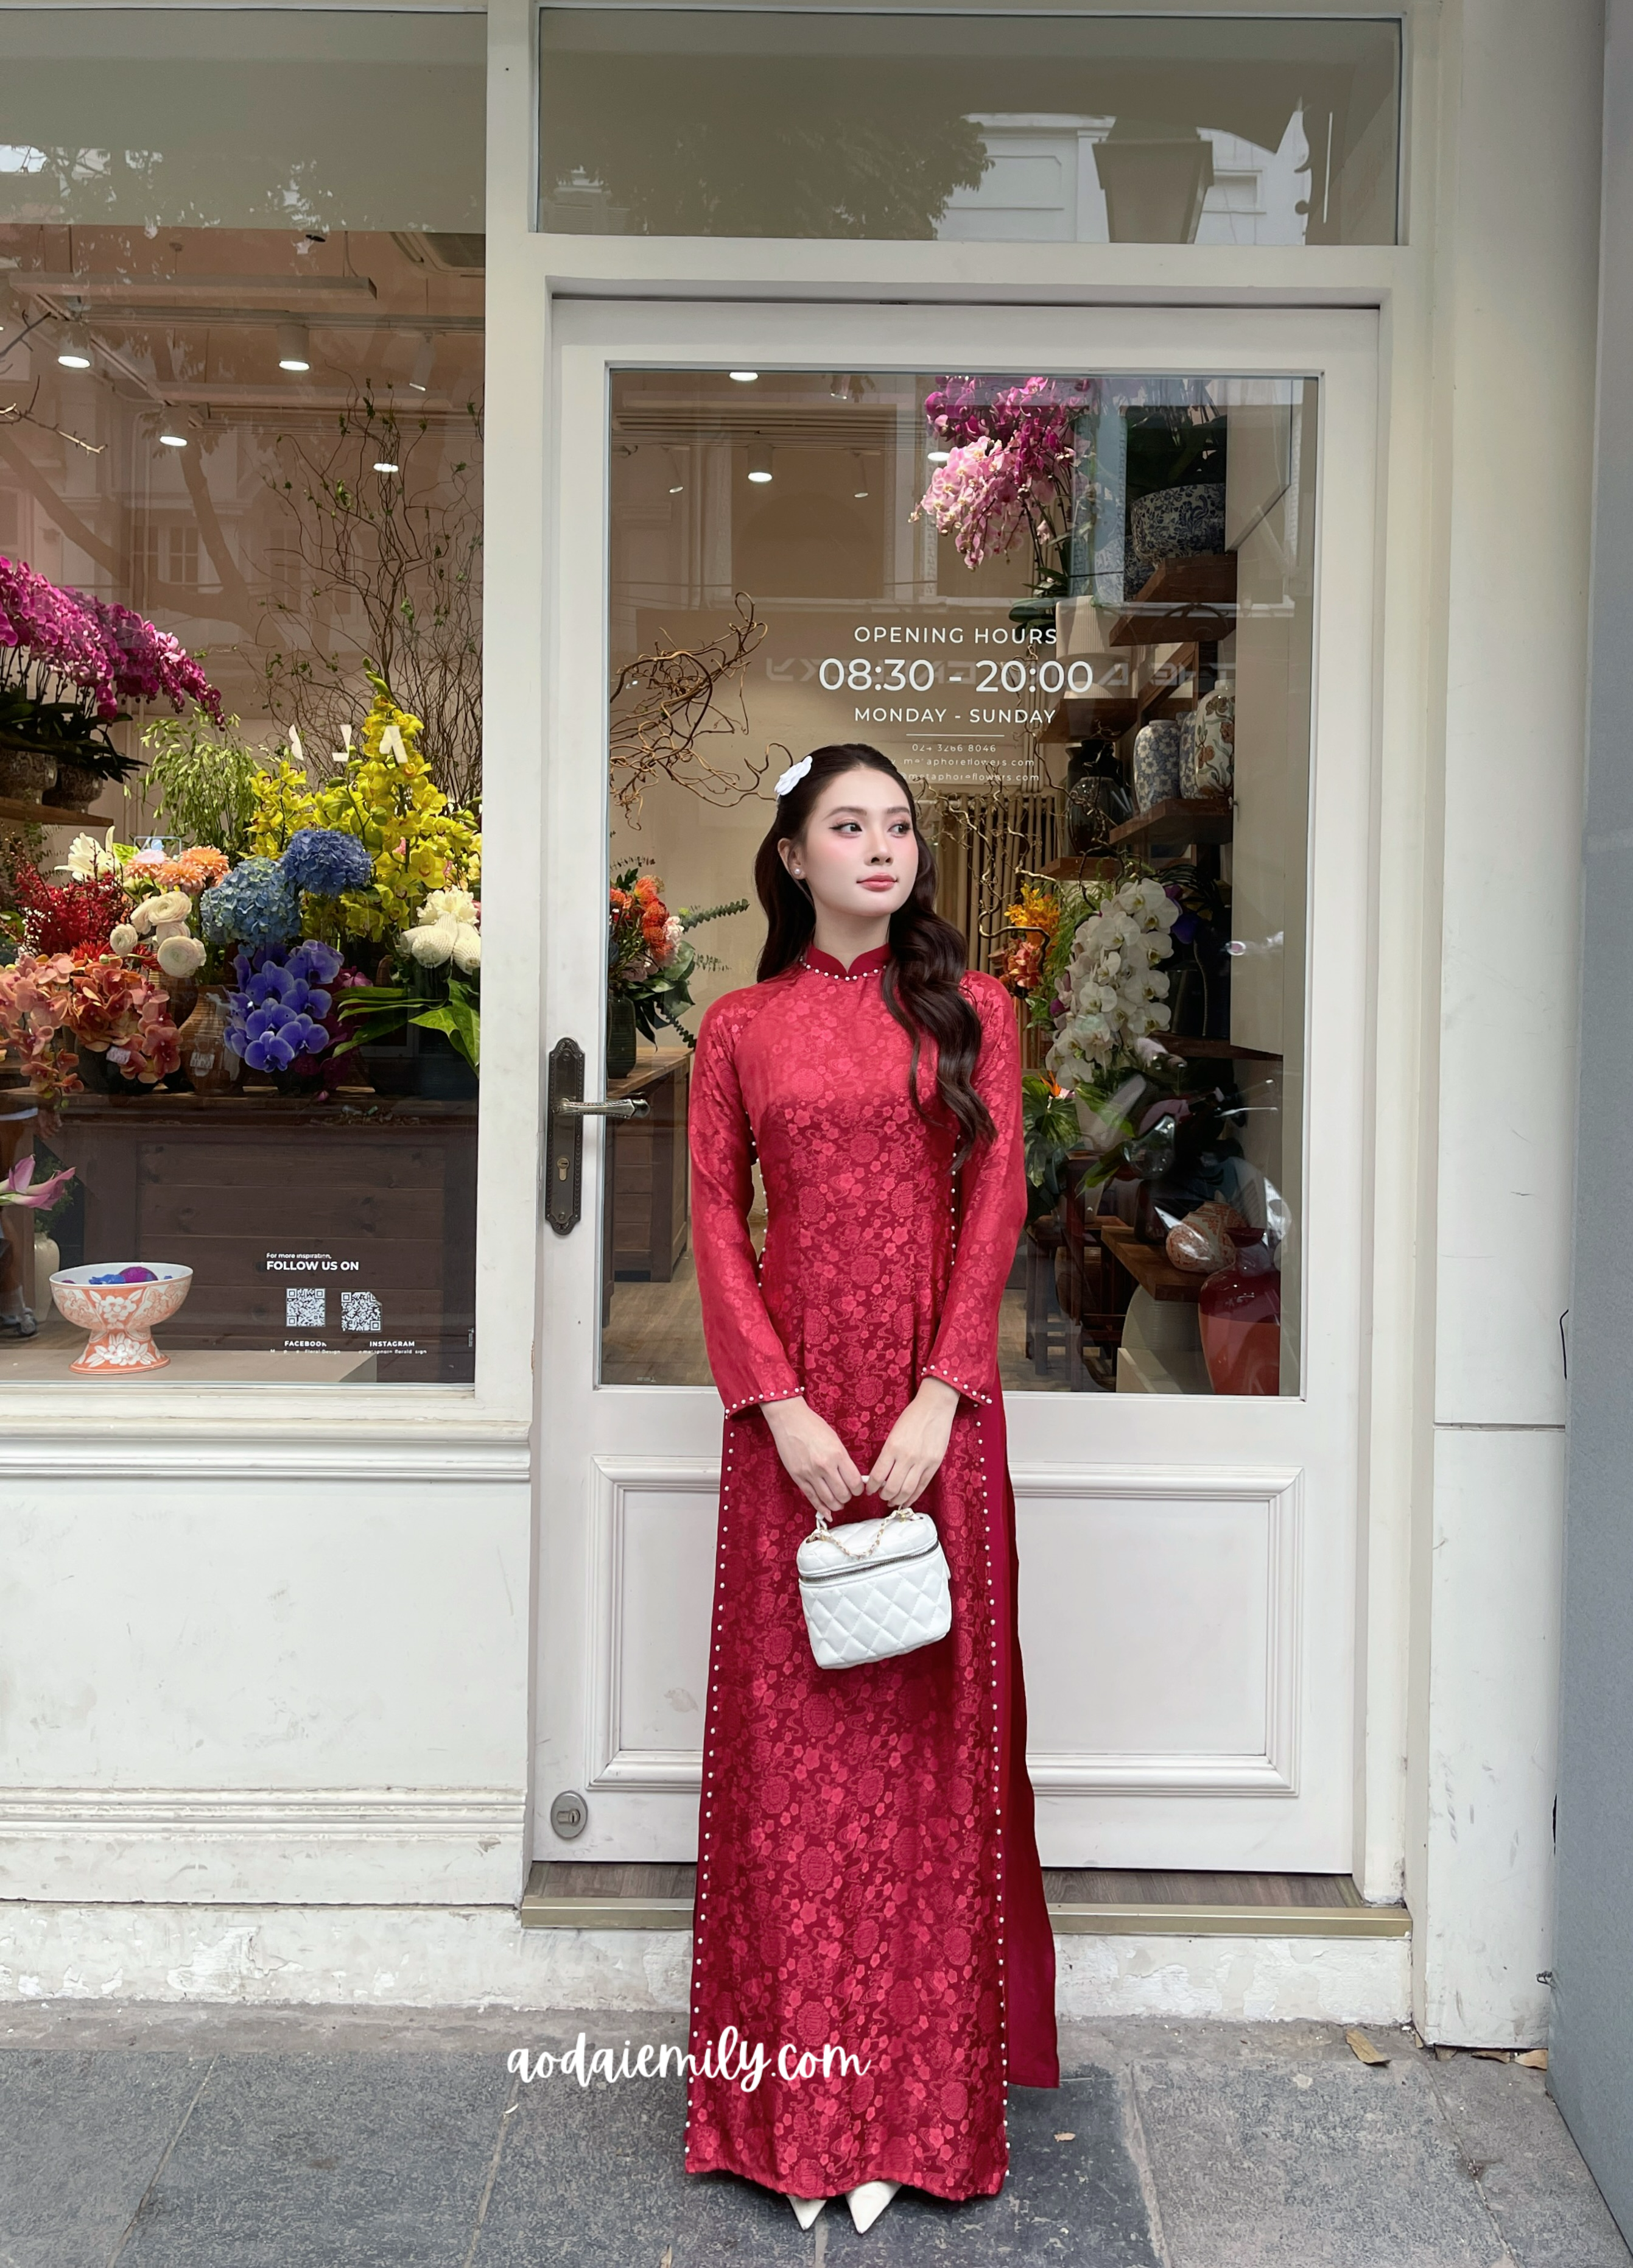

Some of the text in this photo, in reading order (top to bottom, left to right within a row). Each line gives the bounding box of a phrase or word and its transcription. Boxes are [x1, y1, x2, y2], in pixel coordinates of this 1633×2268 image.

[855, 627, 1057, 644] OPENING HOURS
[820, 658, 935, 691] 08:30
[975, 660, 1094, 692] 20:00
[855, 708, 947, 722] MONDAY
[969, 709, 1056, 724] SUNDAY
[266, 1261, 360, 1271] FOLLOW US ON
